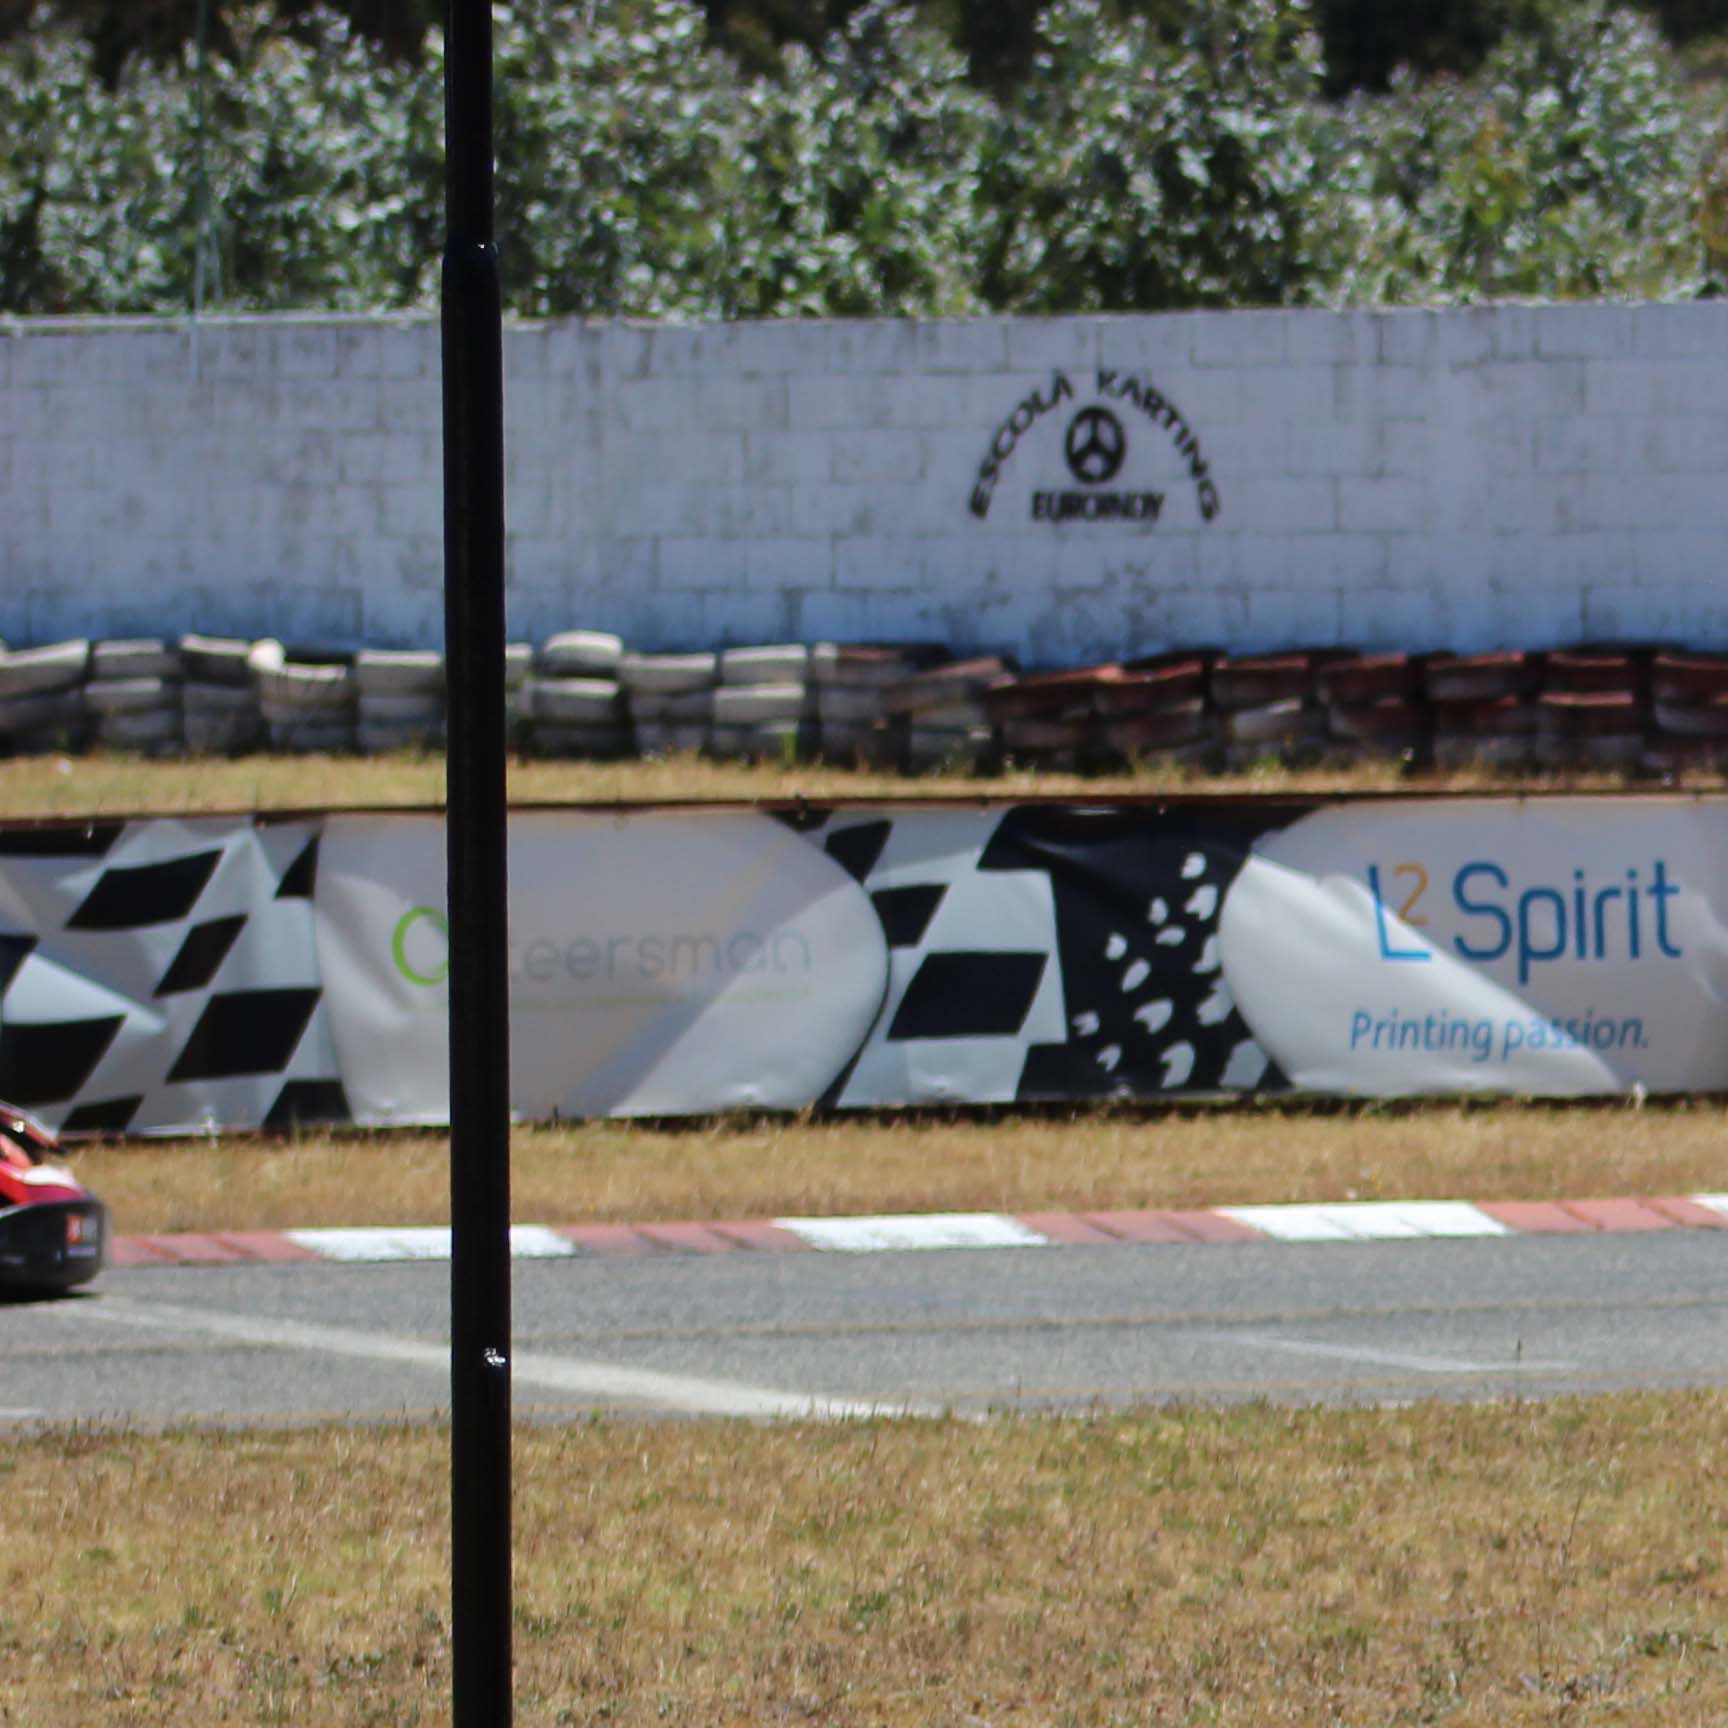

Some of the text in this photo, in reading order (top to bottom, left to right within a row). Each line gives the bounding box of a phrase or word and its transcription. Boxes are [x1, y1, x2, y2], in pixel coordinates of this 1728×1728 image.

[968, 366, 1222, 522] ESCOLA KARTING
[1031, 490, 1165, 522] EUROINDY
[1452, 860, 1682, 986] Spirit
[1350, 1010, 1651, 1063] Printing passion.
